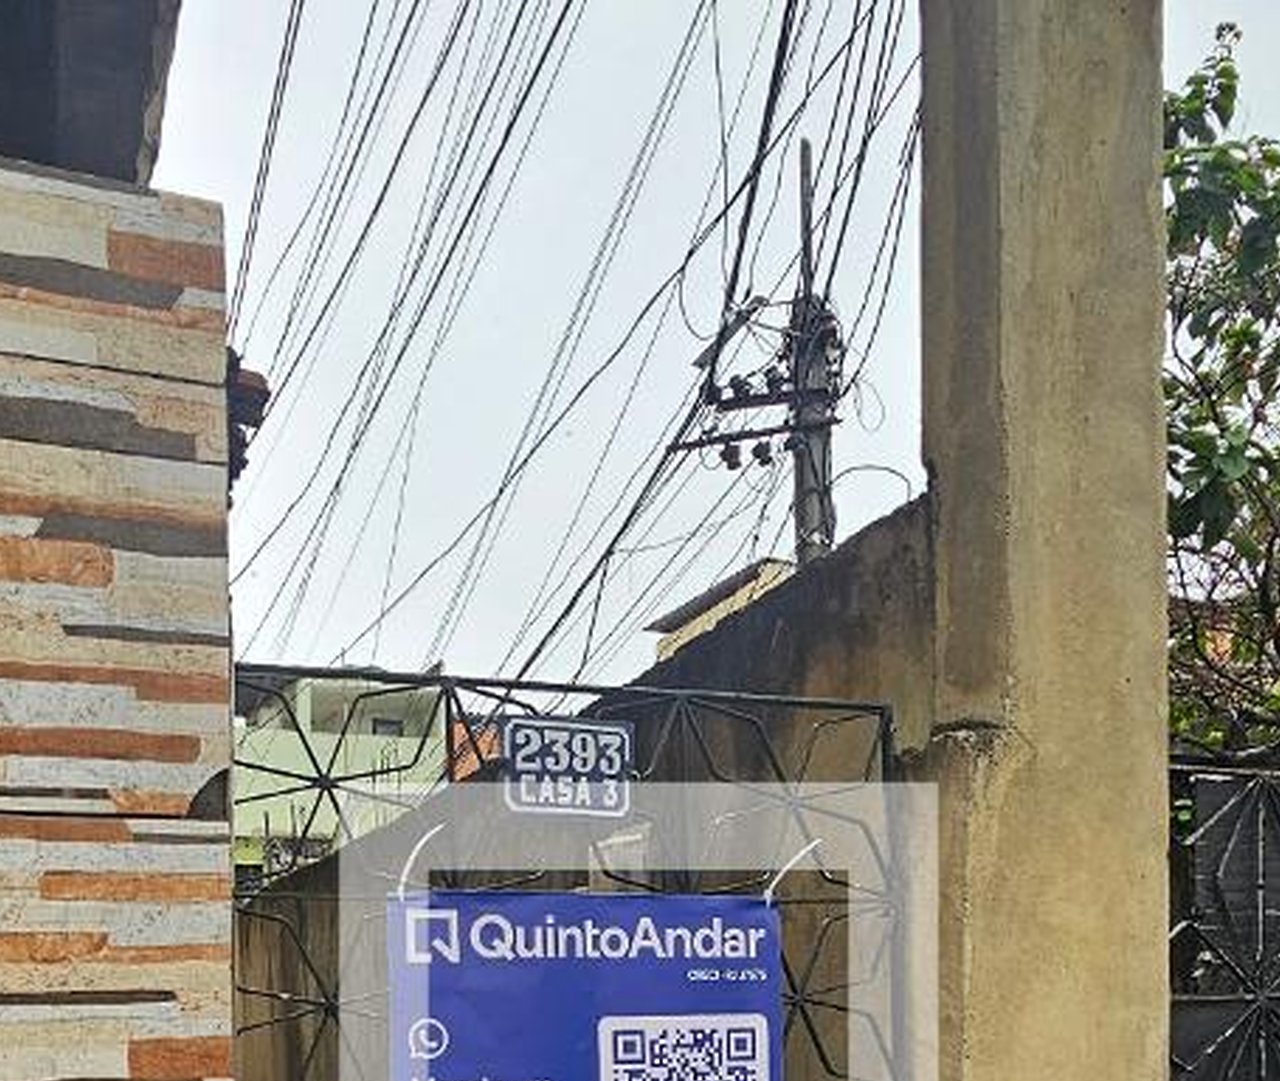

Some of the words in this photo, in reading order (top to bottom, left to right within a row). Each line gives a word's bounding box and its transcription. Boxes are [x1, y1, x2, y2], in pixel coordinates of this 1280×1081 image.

[515, 729, 621, 775] 2393
[521, 773, 591, 806] CASA
[603, 778, 618, 808] 3
[470, 913, 765, 961] QuintoAndar
